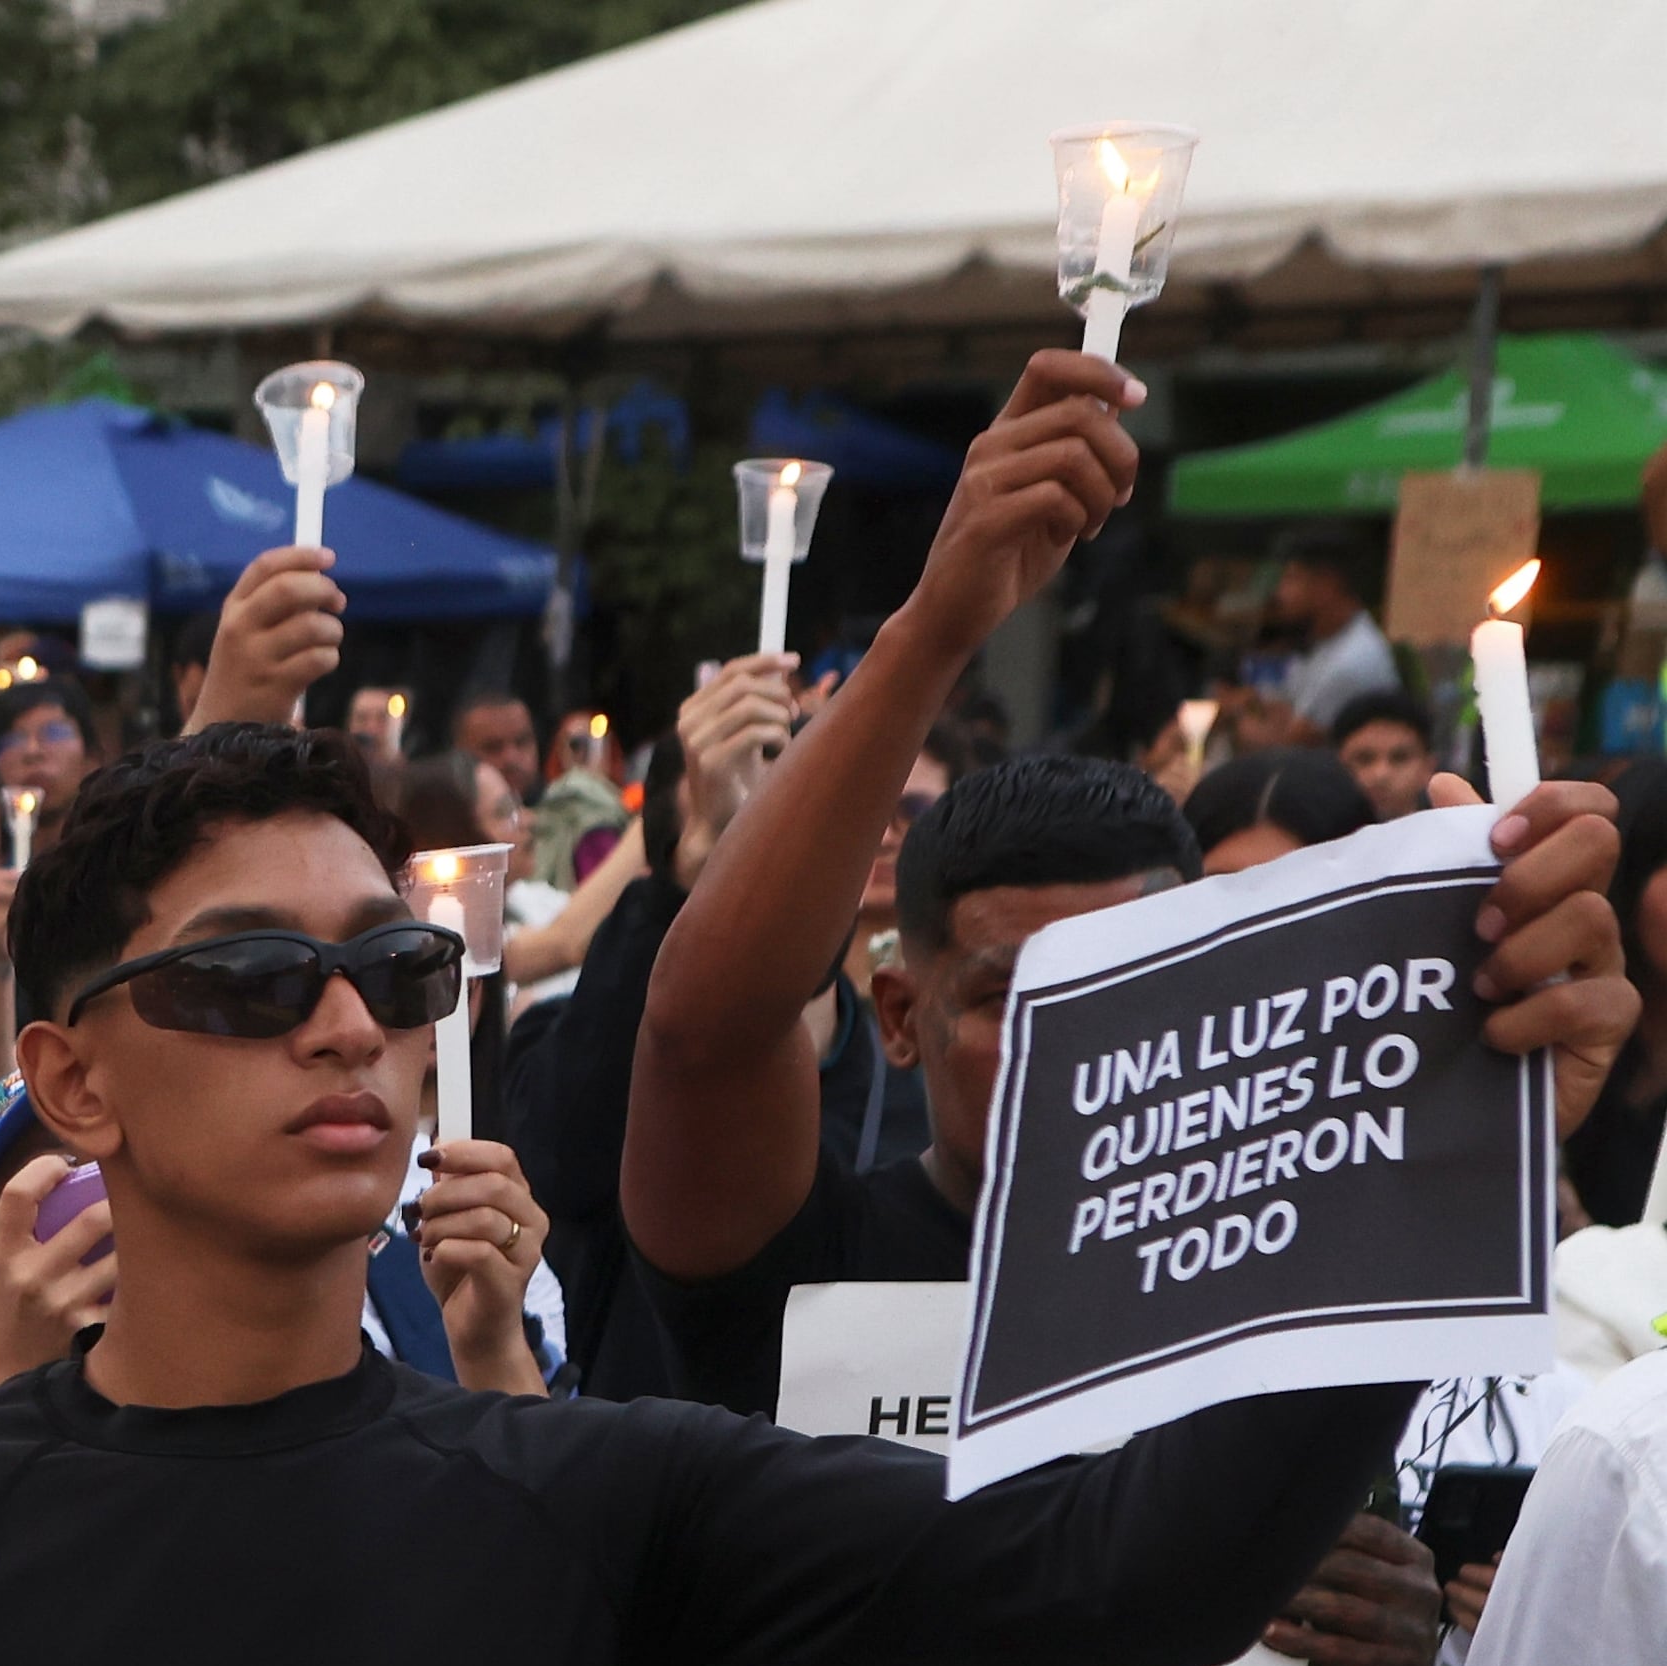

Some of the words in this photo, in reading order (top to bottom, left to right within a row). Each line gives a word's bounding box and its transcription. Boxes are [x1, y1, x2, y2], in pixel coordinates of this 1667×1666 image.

[1072, 1030, 1183, 1115] UNA
[1197, 988, 1308, 1070] LUZ
[1320, 957, 1456, 1034] POR
[1081, 1056, 1319, 1181] QUIENES
[1328, 1033, 1420, 1099] LO
[1067, 1106, 1405, 1254] PERDIERON
[1137, 1199, 1299, 1293] TODO
[869, 1395, 952, 1435] HE
